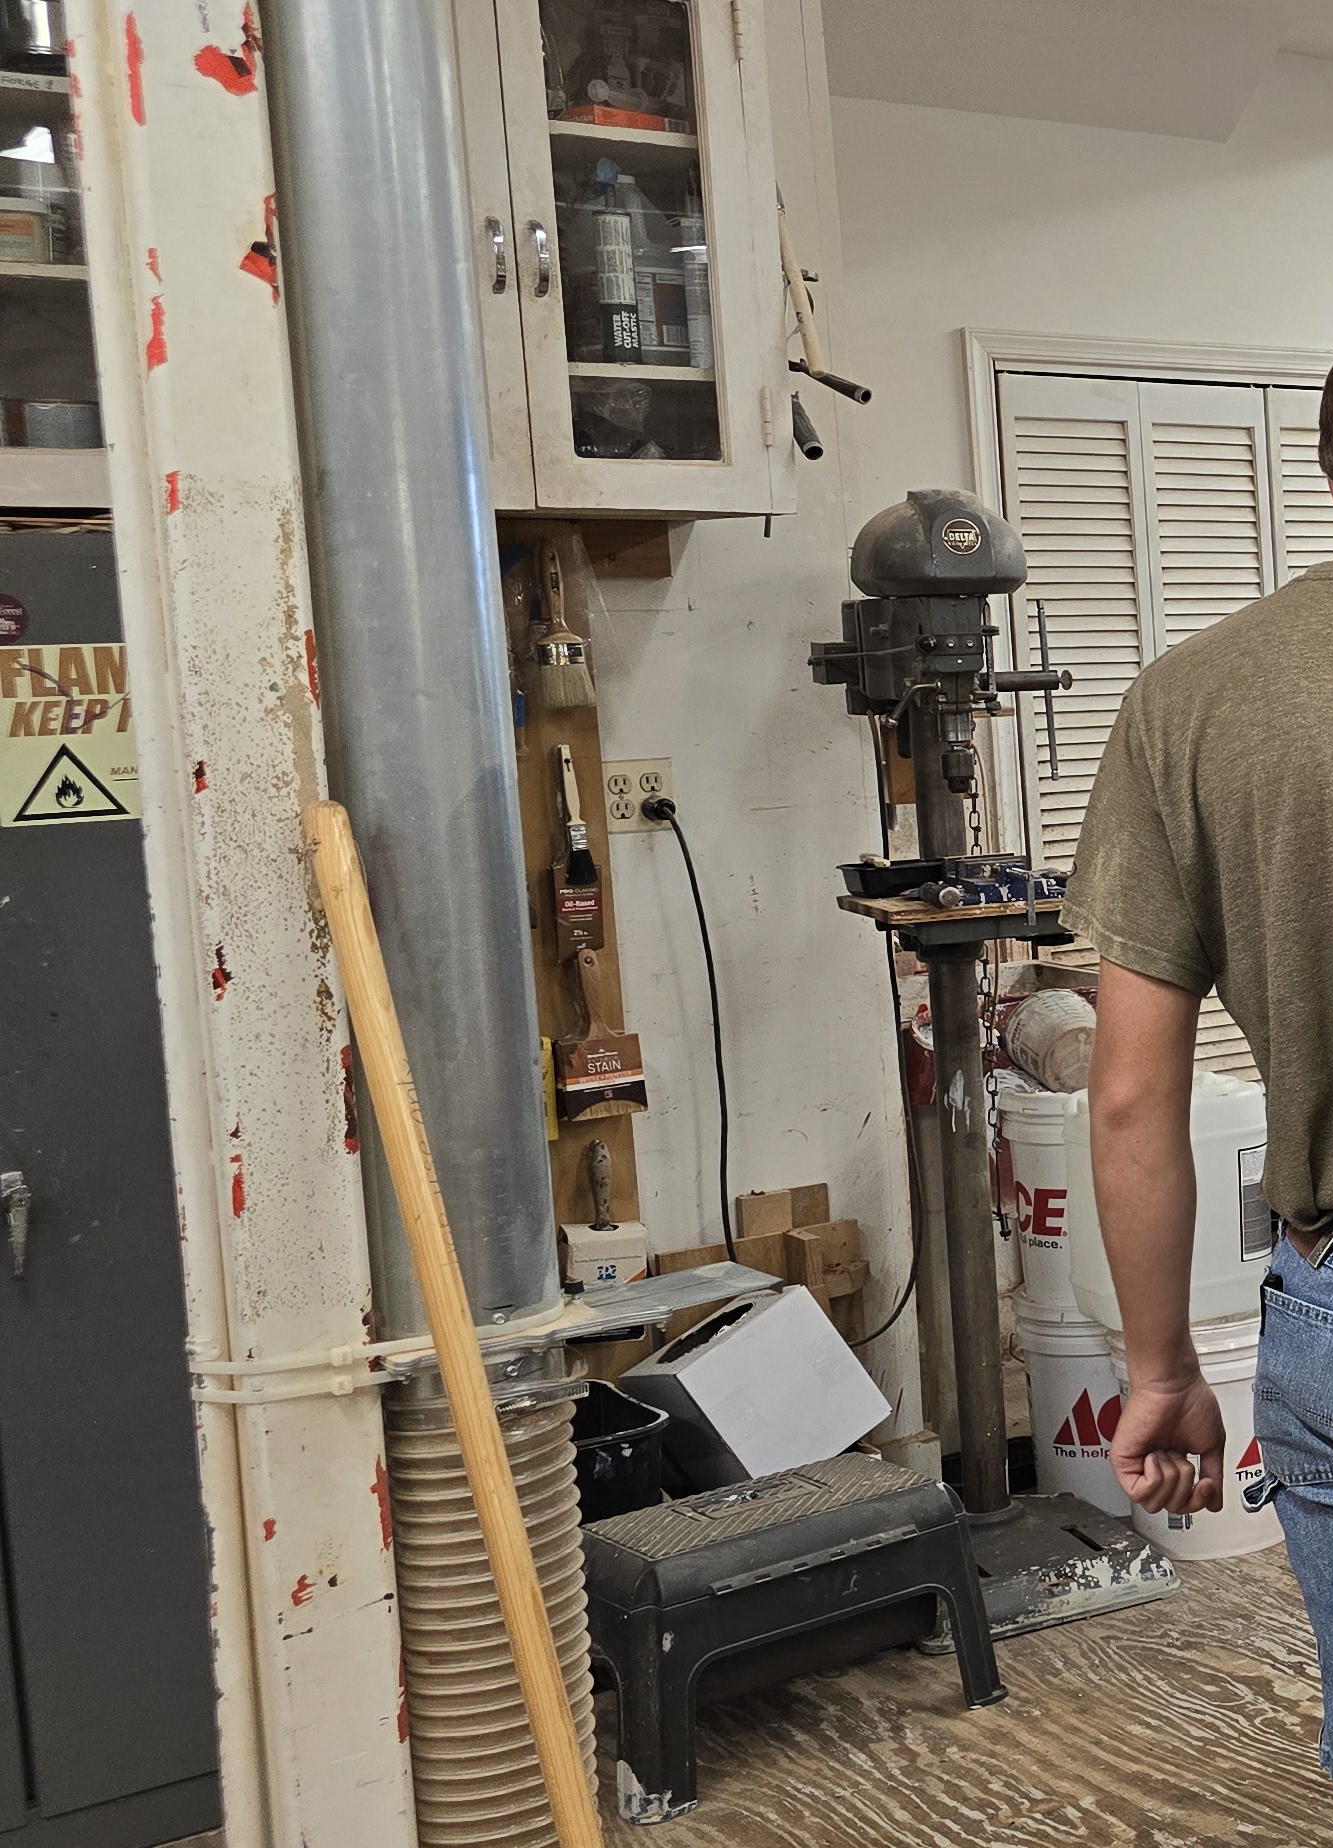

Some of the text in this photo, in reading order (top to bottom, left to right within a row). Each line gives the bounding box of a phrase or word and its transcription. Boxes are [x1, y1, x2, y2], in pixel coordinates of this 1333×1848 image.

[612, 314, 623, 347] WATER
[621, 310, 632, 349] CUT-OFF
[630, 312, 639, 348] MASTIC
[949, 532, 976, 542] DELTA
[8, 698, 111, 738] KEEP
[564, 899, 596, 908] Oil-Based
[587, 1059, 622, 1074] STAIN
[1028, 1236, 1063, 1250] place.
[597, 1264, 617, 1280] PPG
[1053, 1445, 1077, 1459] The
[1234, 1469, 1263, 1482] The
